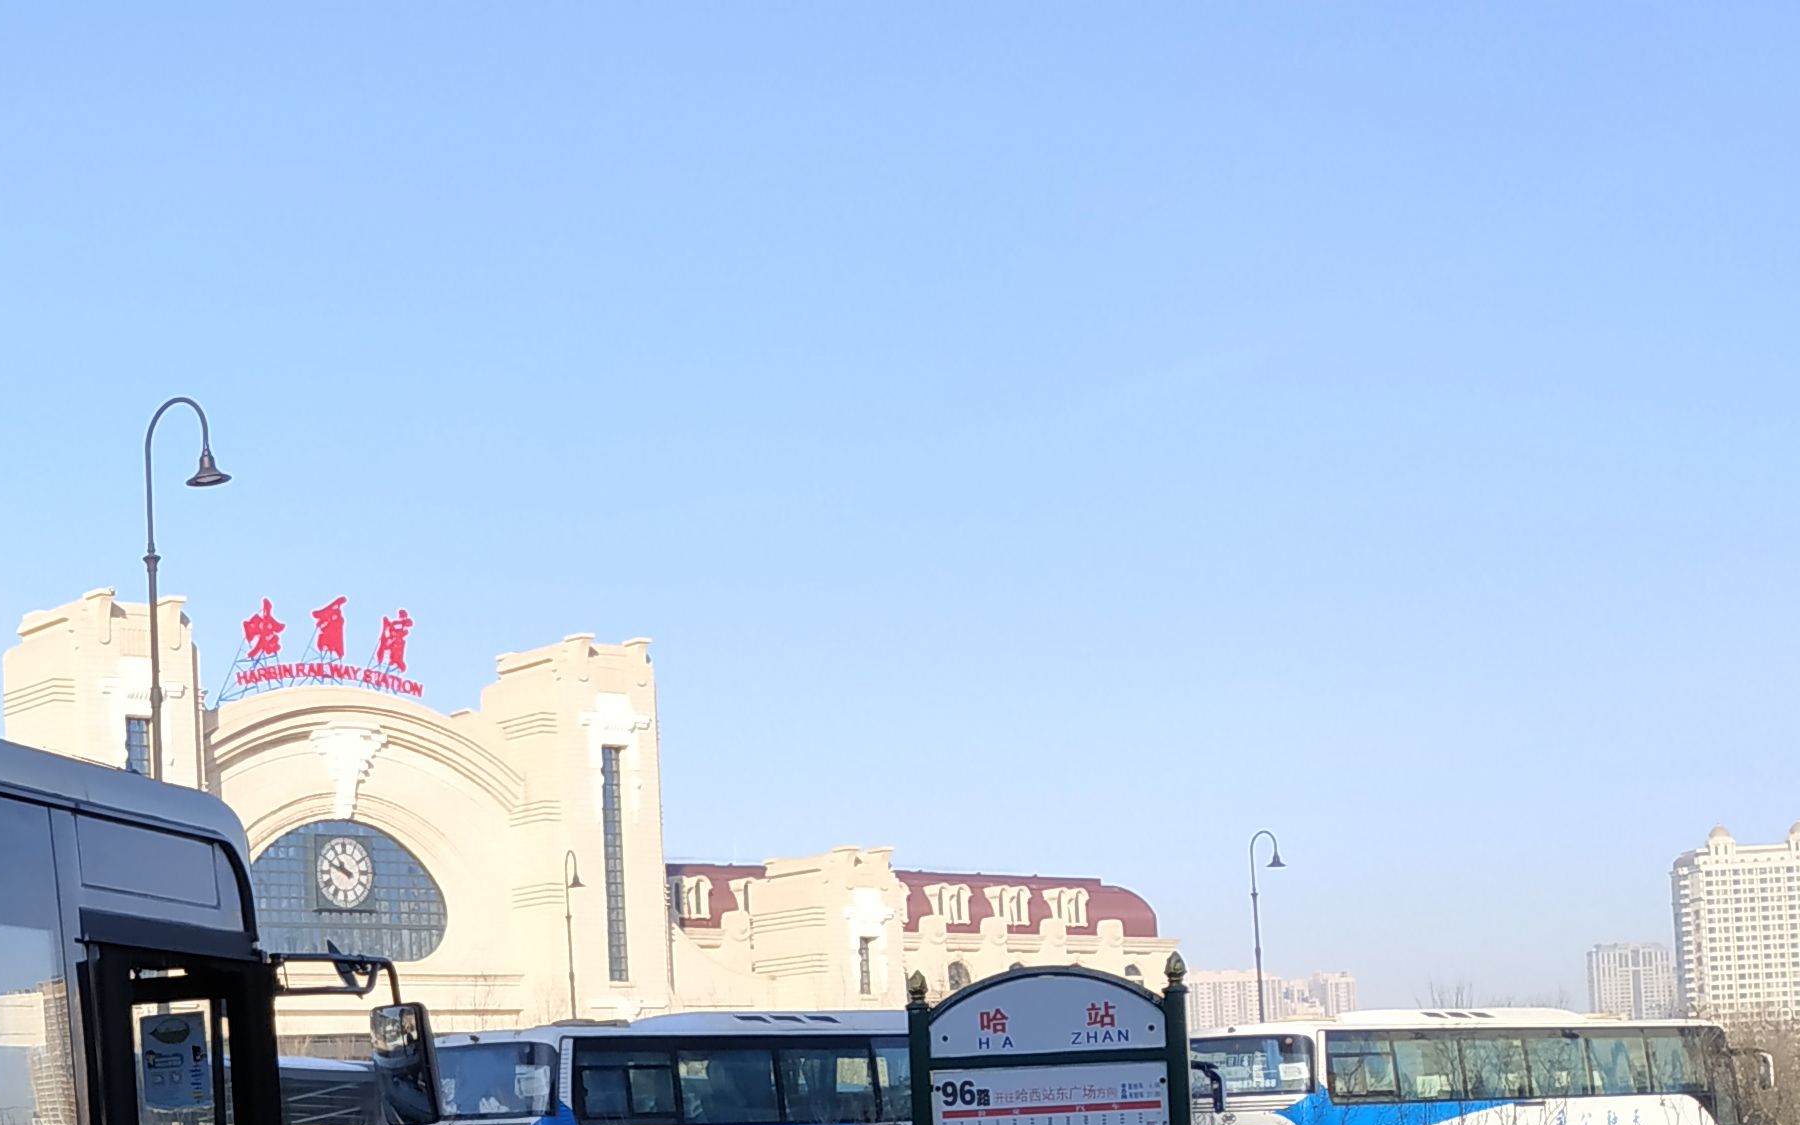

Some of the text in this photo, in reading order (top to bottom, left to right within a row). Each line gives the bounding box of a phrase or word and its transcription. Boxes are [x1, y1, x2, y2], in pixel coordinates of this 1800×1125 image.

[236, 662, 424, 698] HARBIN RAILWAY STATION
[979, 1002, 1117, 1035] 哈 站
[1071, 1029, 1131, 1045] ZHAN
